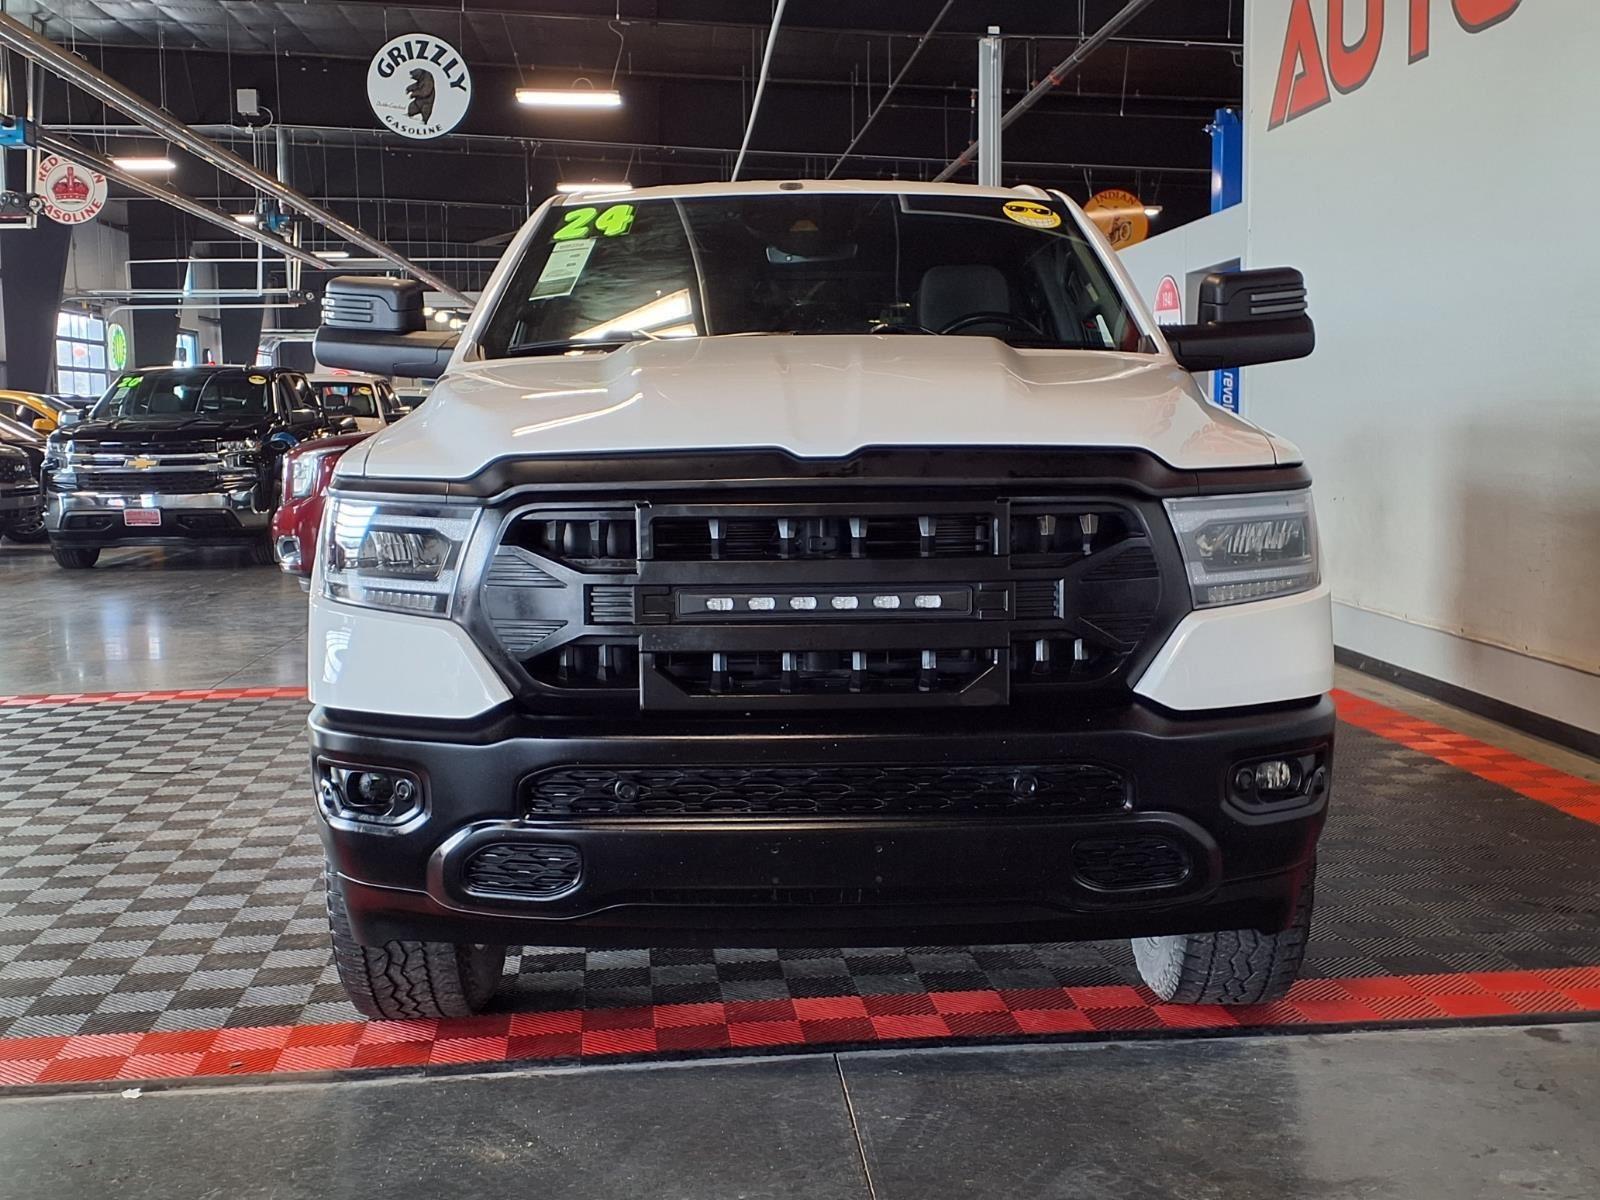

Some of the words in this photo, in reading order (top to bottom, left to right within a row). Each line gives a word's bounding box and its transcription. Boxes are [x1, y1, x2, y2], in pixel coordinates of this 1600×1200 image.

[377, 40, 466, 92] GRIZZLY
[1267, 0, 1522, 131] AU
[385, 115, 443, 135] GASOLINE
[38, 156, 58, 182] RED
[1094, 191, 1138, 206] INDIAN
[553, 204, 634, 240] 24
[116, 376, 144, 388] 20
[1222, 371, 1235, 412] revol
